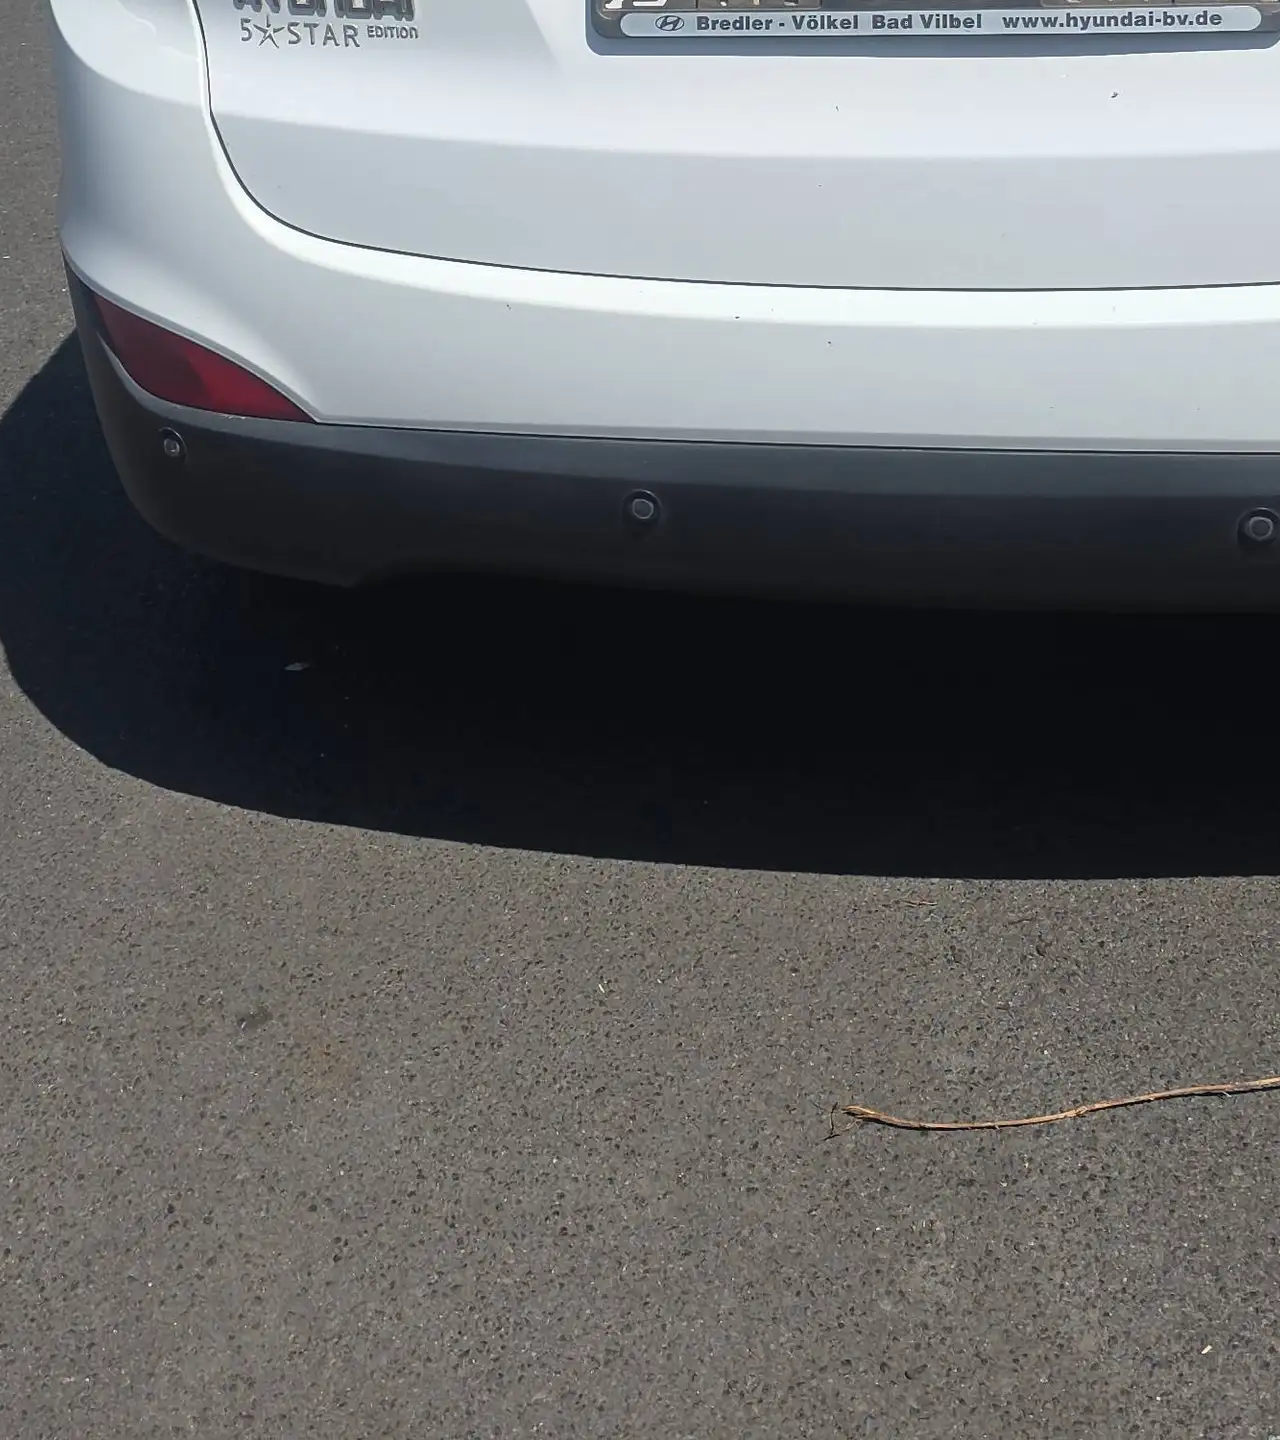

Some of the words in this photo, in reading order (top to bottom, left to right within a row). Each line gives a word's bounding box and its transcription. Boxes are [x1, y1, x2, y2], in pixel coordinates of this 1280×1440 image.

[696, 14, 773, 31] Bredler
[791, 13, 859, 31] Völkel
[872, 13, 913, 30] Bad
[920, 13, 983, 30] Vilbel
[1002, 10, 1223, 31] www.hyundai-bv.de
[366, 24, 419, 40] EDITION
